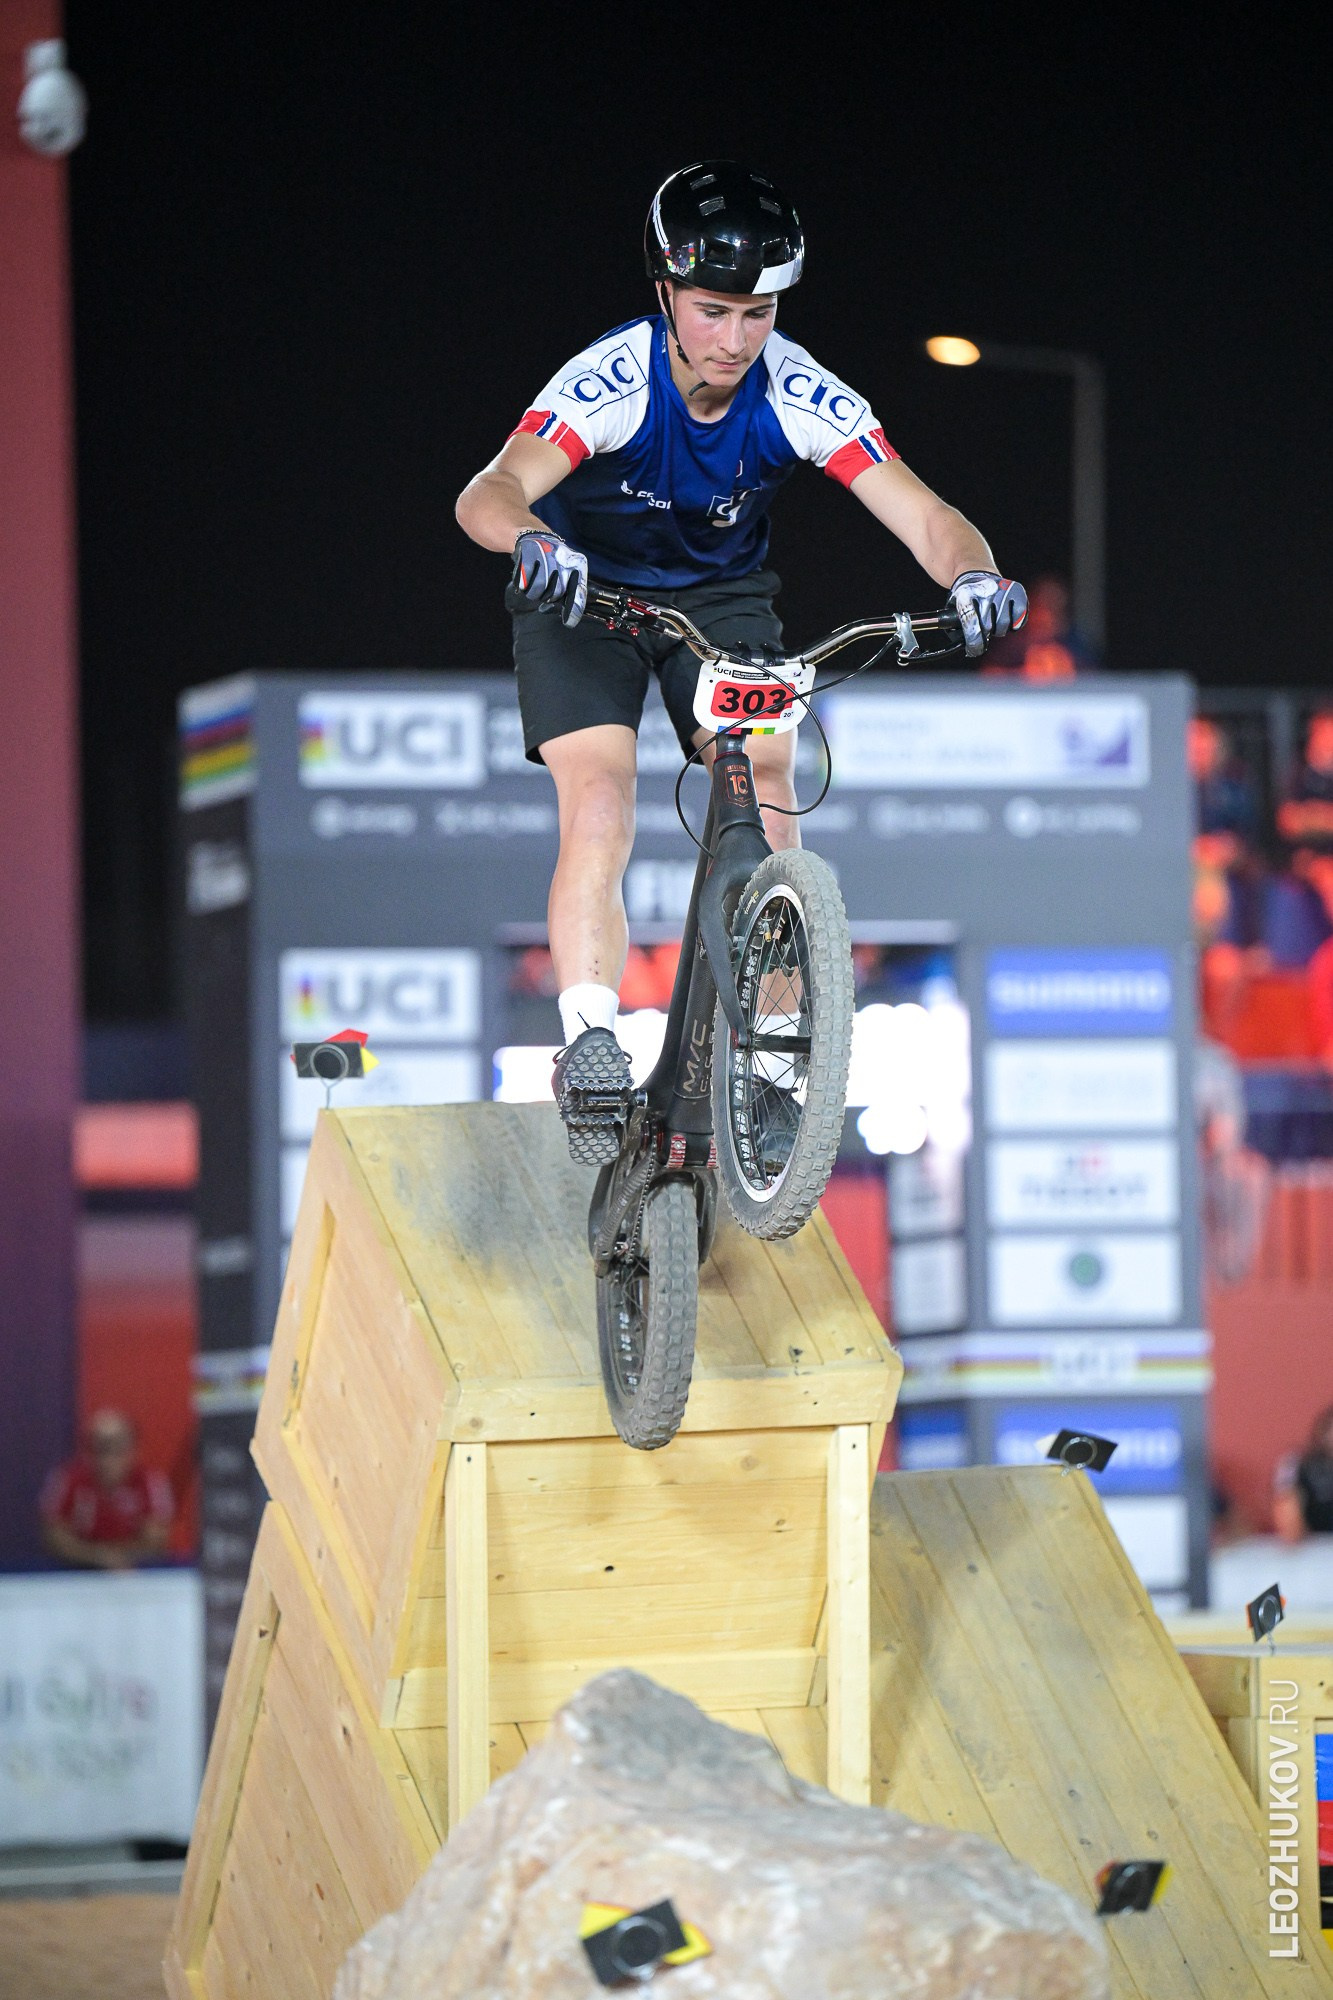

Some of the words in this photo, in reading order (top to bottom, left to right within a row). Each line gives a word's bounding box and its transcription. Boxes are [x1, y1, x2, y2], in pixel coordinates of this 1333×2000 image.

[573, 356, 634, 403] CIC
[783, 372, 856, 422] CIC
[717, 667, 732, 676] UCI
[717, 687, 787, 715] 303
[334, 713, 462, 768] UCI
[729, 774, 748, 795] 10
[324, 970, 455, 1022] UCI
